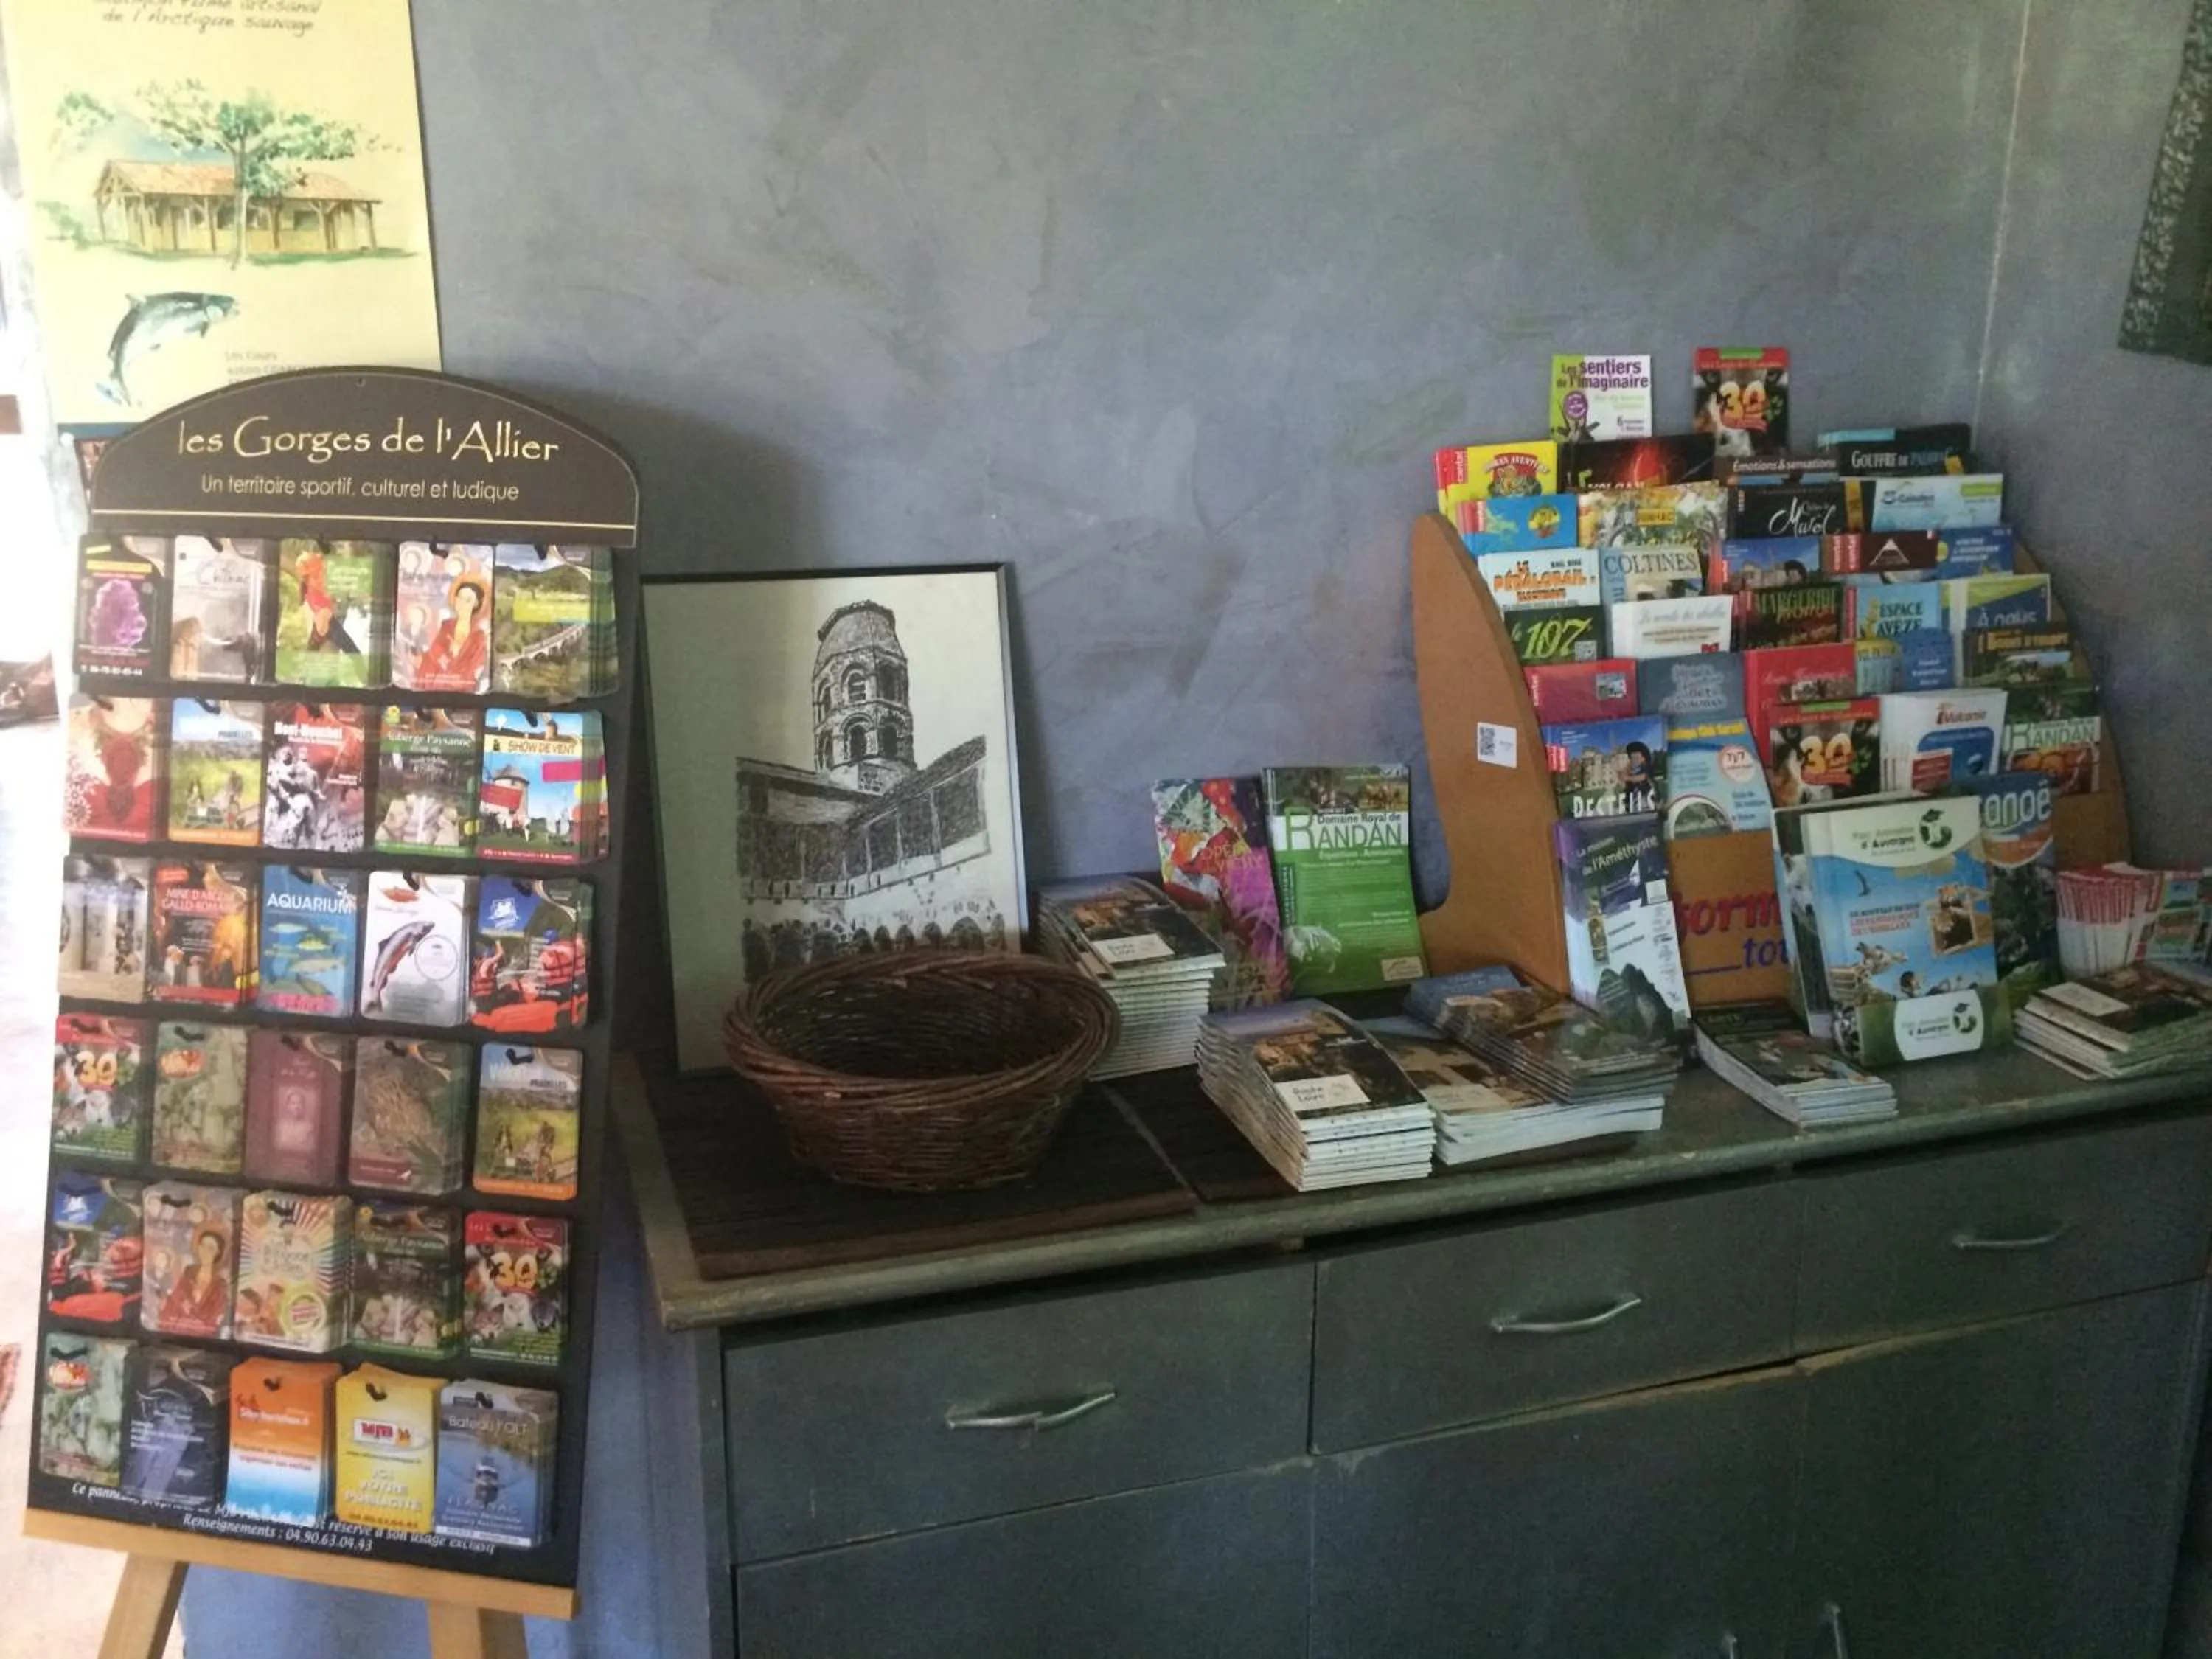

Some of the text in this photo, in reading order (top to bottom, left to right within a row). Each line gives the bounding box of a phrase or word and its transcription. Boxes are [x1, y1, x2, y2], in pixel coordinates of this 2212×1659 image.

[1579, 358, 1642, 376] sentiers
[1568, 373, 1649, 392] l'imaginaire
[178, 415, 559, 465] les Gorges de l'Allier
[201, 474, 223, 494] Un
[228, 474, 296, 495] territoire
[361, 477, 425, 498] culturel
[430, 480, 448, 498] et
[452, 480, 520, 504] ludique
[1604, 552, 1696, 575] COLTINES
[1879, 601, 1924, 617] ESPACE
[1521, 616, 1593, 659] 107
[1980, 778, 2052, 827] anoë
[1284, 805, 1402, 849] RANDAN
[1317, 813, 1401, 826] Domaine Royal de
[266, 891, 357, 915] AQUARIUM
[72, 1481, 86, 1495] Ce
[182, 1512, 276, 1539] Renseignements
[285, 1525, 374, 1554] 04.90.63.04.43
